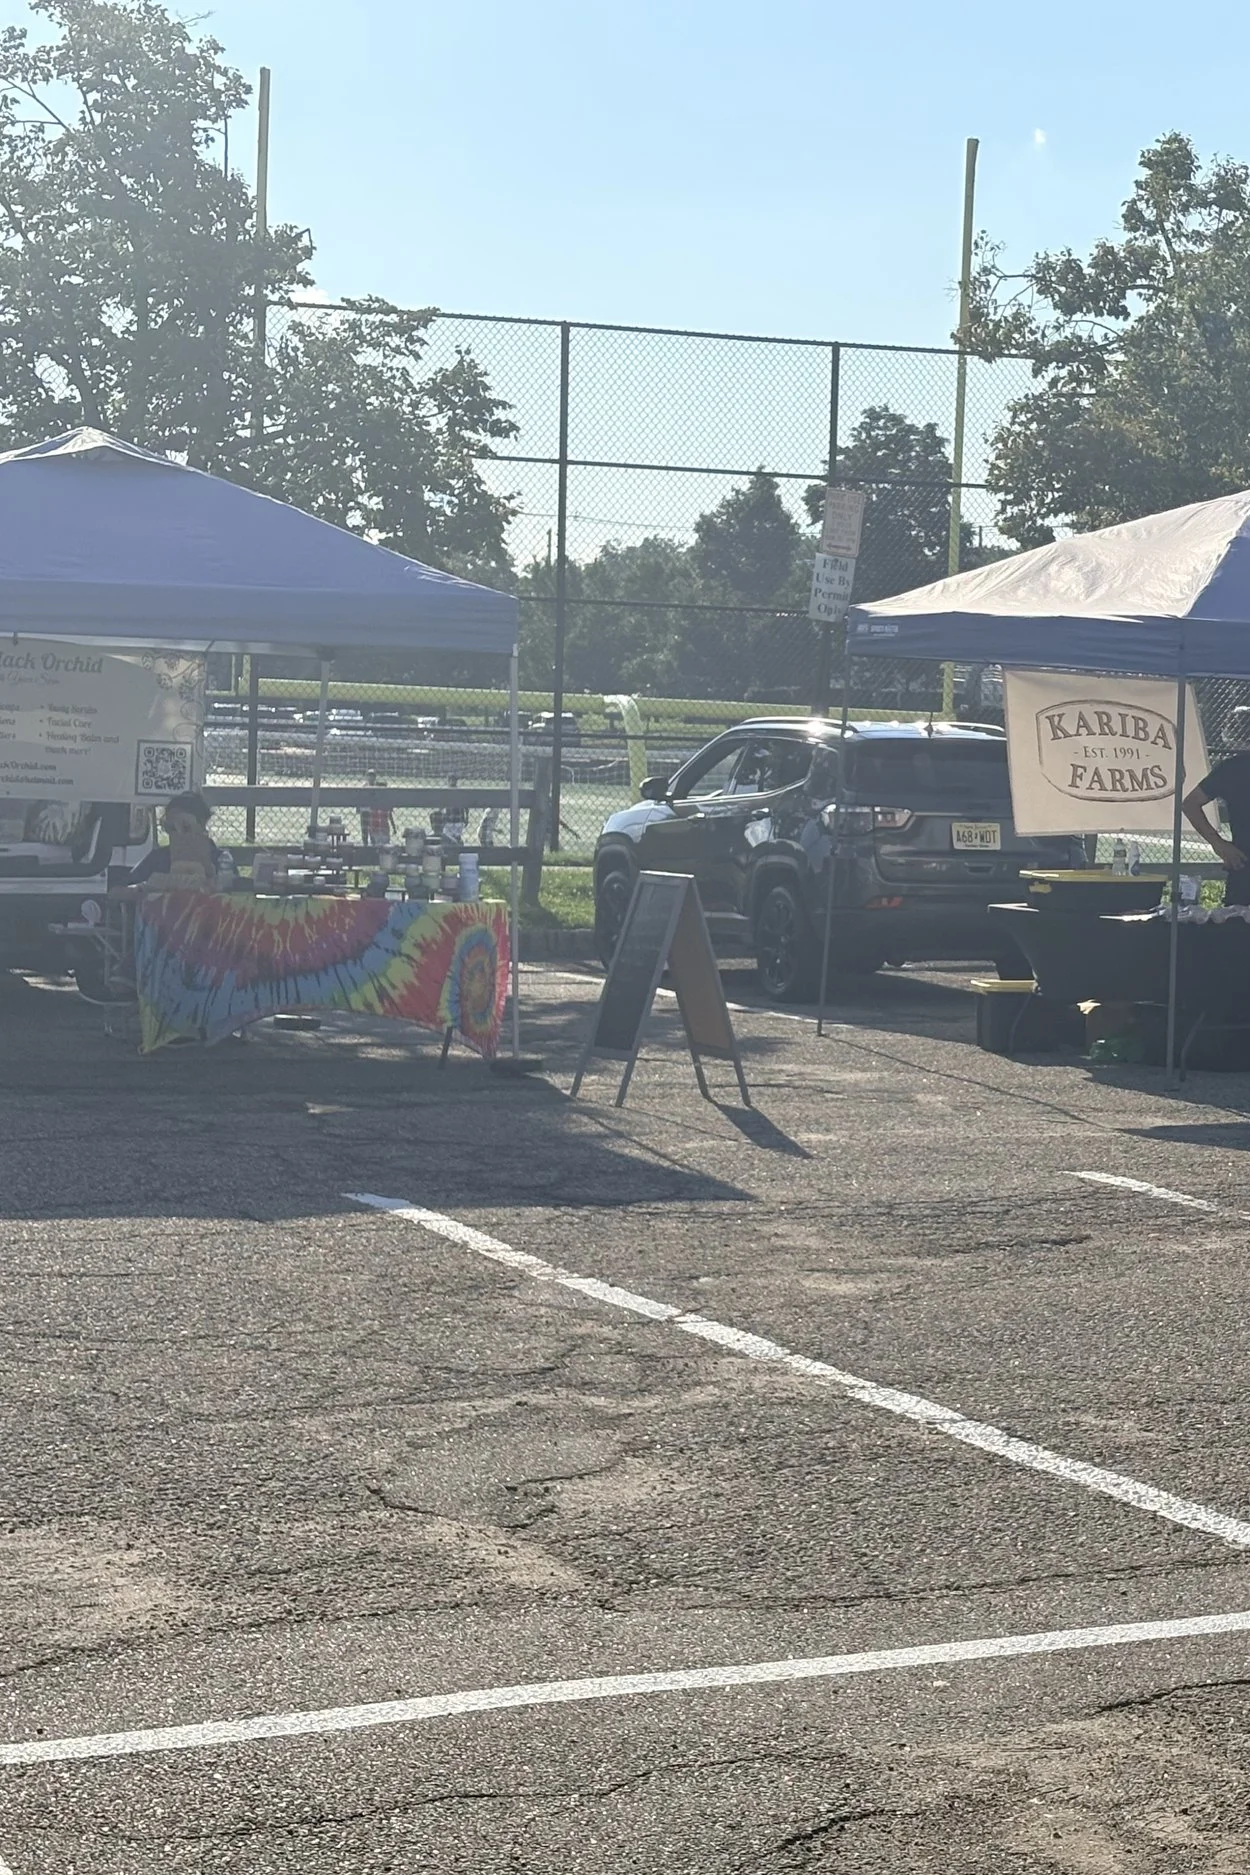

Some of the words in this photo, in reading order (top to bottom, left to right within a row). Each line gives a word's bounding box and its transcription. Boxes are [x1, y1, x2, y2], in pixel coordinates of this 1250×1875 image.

[832, 511, 853, 521] ONLY
[822, 558, 848, 572] Field
[816, 572, 835, 585] Use
[838, 575, 850, 587] By
[814, 587, 849, 601] Permit
[0, 651, 36, 669] lack
[41, 652, 104, 673] Orchid
[1045, 711, 1172, 750] KARIBA
[1083, 746, 1108, 759] EST.
[1114, 748, 1140, 760] 1991
[1068, 763, 1167, 792] FARMS
[956, 829, 973, 843] A68
